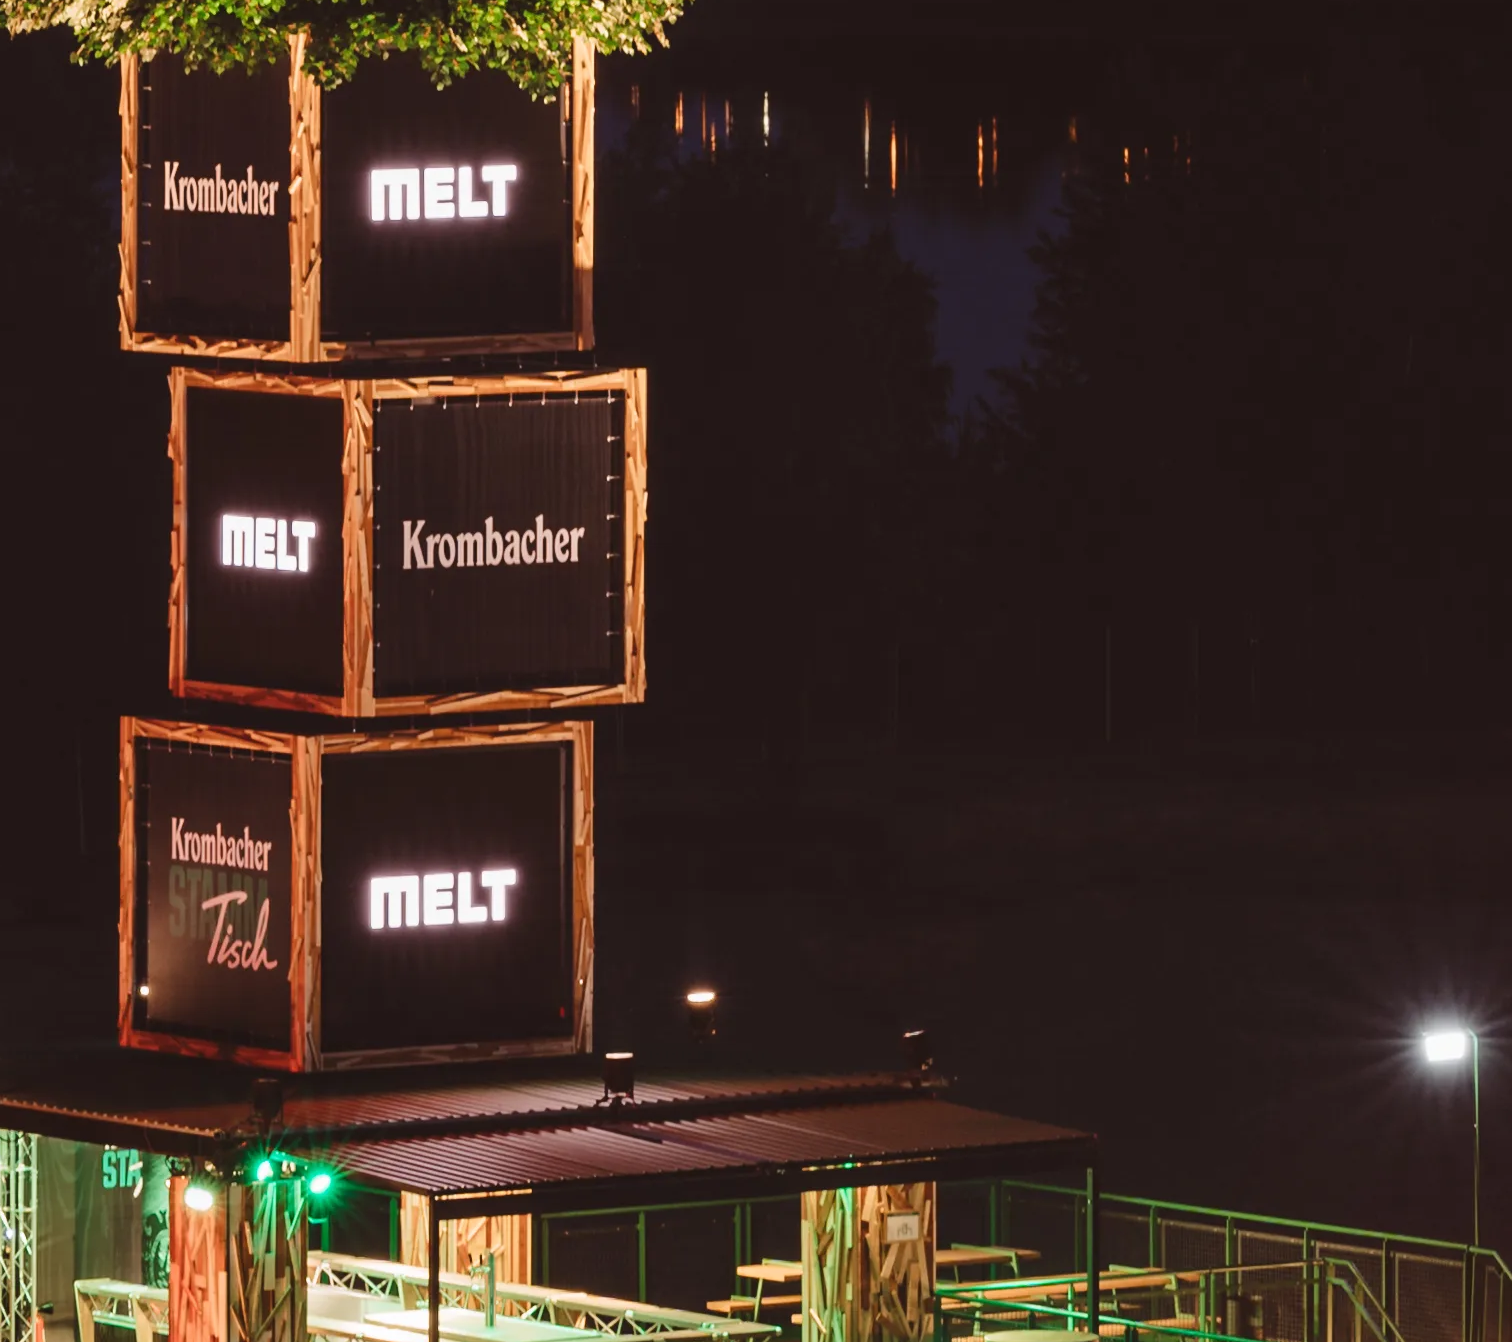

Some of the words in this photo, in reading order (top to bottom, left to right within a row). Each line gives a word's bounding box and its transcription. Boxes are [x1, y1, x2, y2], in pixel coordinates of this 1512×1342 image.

[164, 160, 279, 216] Krombacher
[369, 164, 517, 221] MELT
[222, 515, 316, 573] MELT
[403, 515, 585, 570] Krombacher
[171, 816, 272, 872] Krombacher
[369, 868, 517, 929] MELT
[201, 890, 278, 971] Tisch
